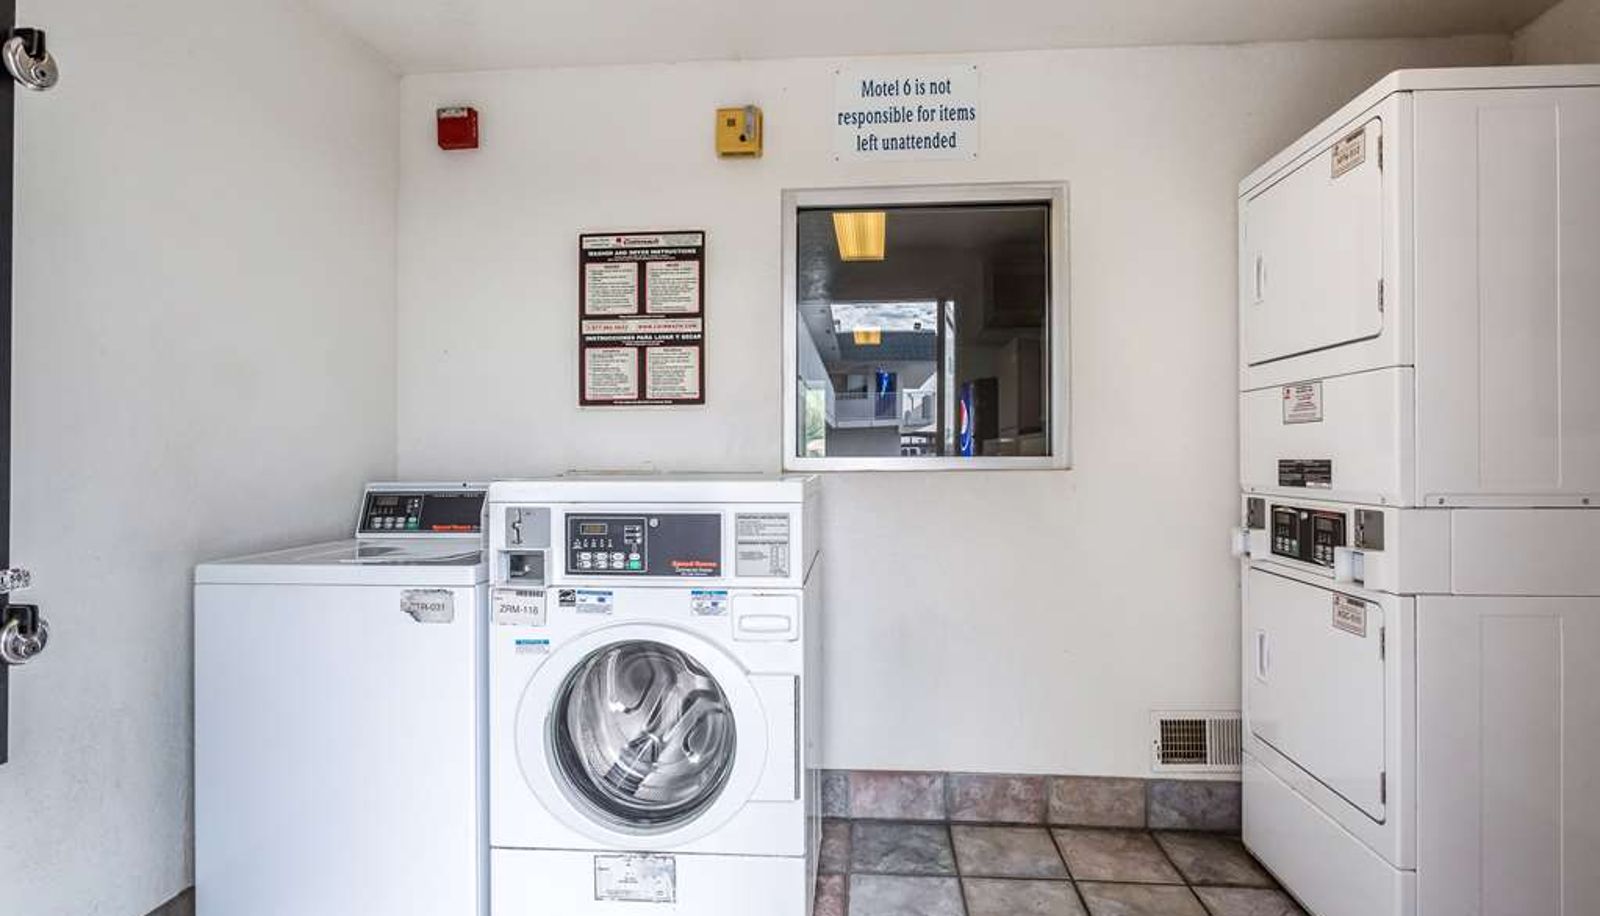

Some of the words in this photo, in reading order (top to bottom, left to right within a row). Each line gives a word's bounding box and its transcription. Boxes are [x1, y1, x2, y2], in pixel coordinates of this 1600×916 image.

[861, 80, 899, 98] Motel
[903, 78, 911, 96] 6
[915, 78, 926, 96] is
[929, 78, 952, 95] not
[837, 106, 913, 129] responsible
[917, 104, 936, 122] for
[939, 104, 976, 122] items
[856, 133, 879, 151] left
[881, 131, 957, 151] unattended
